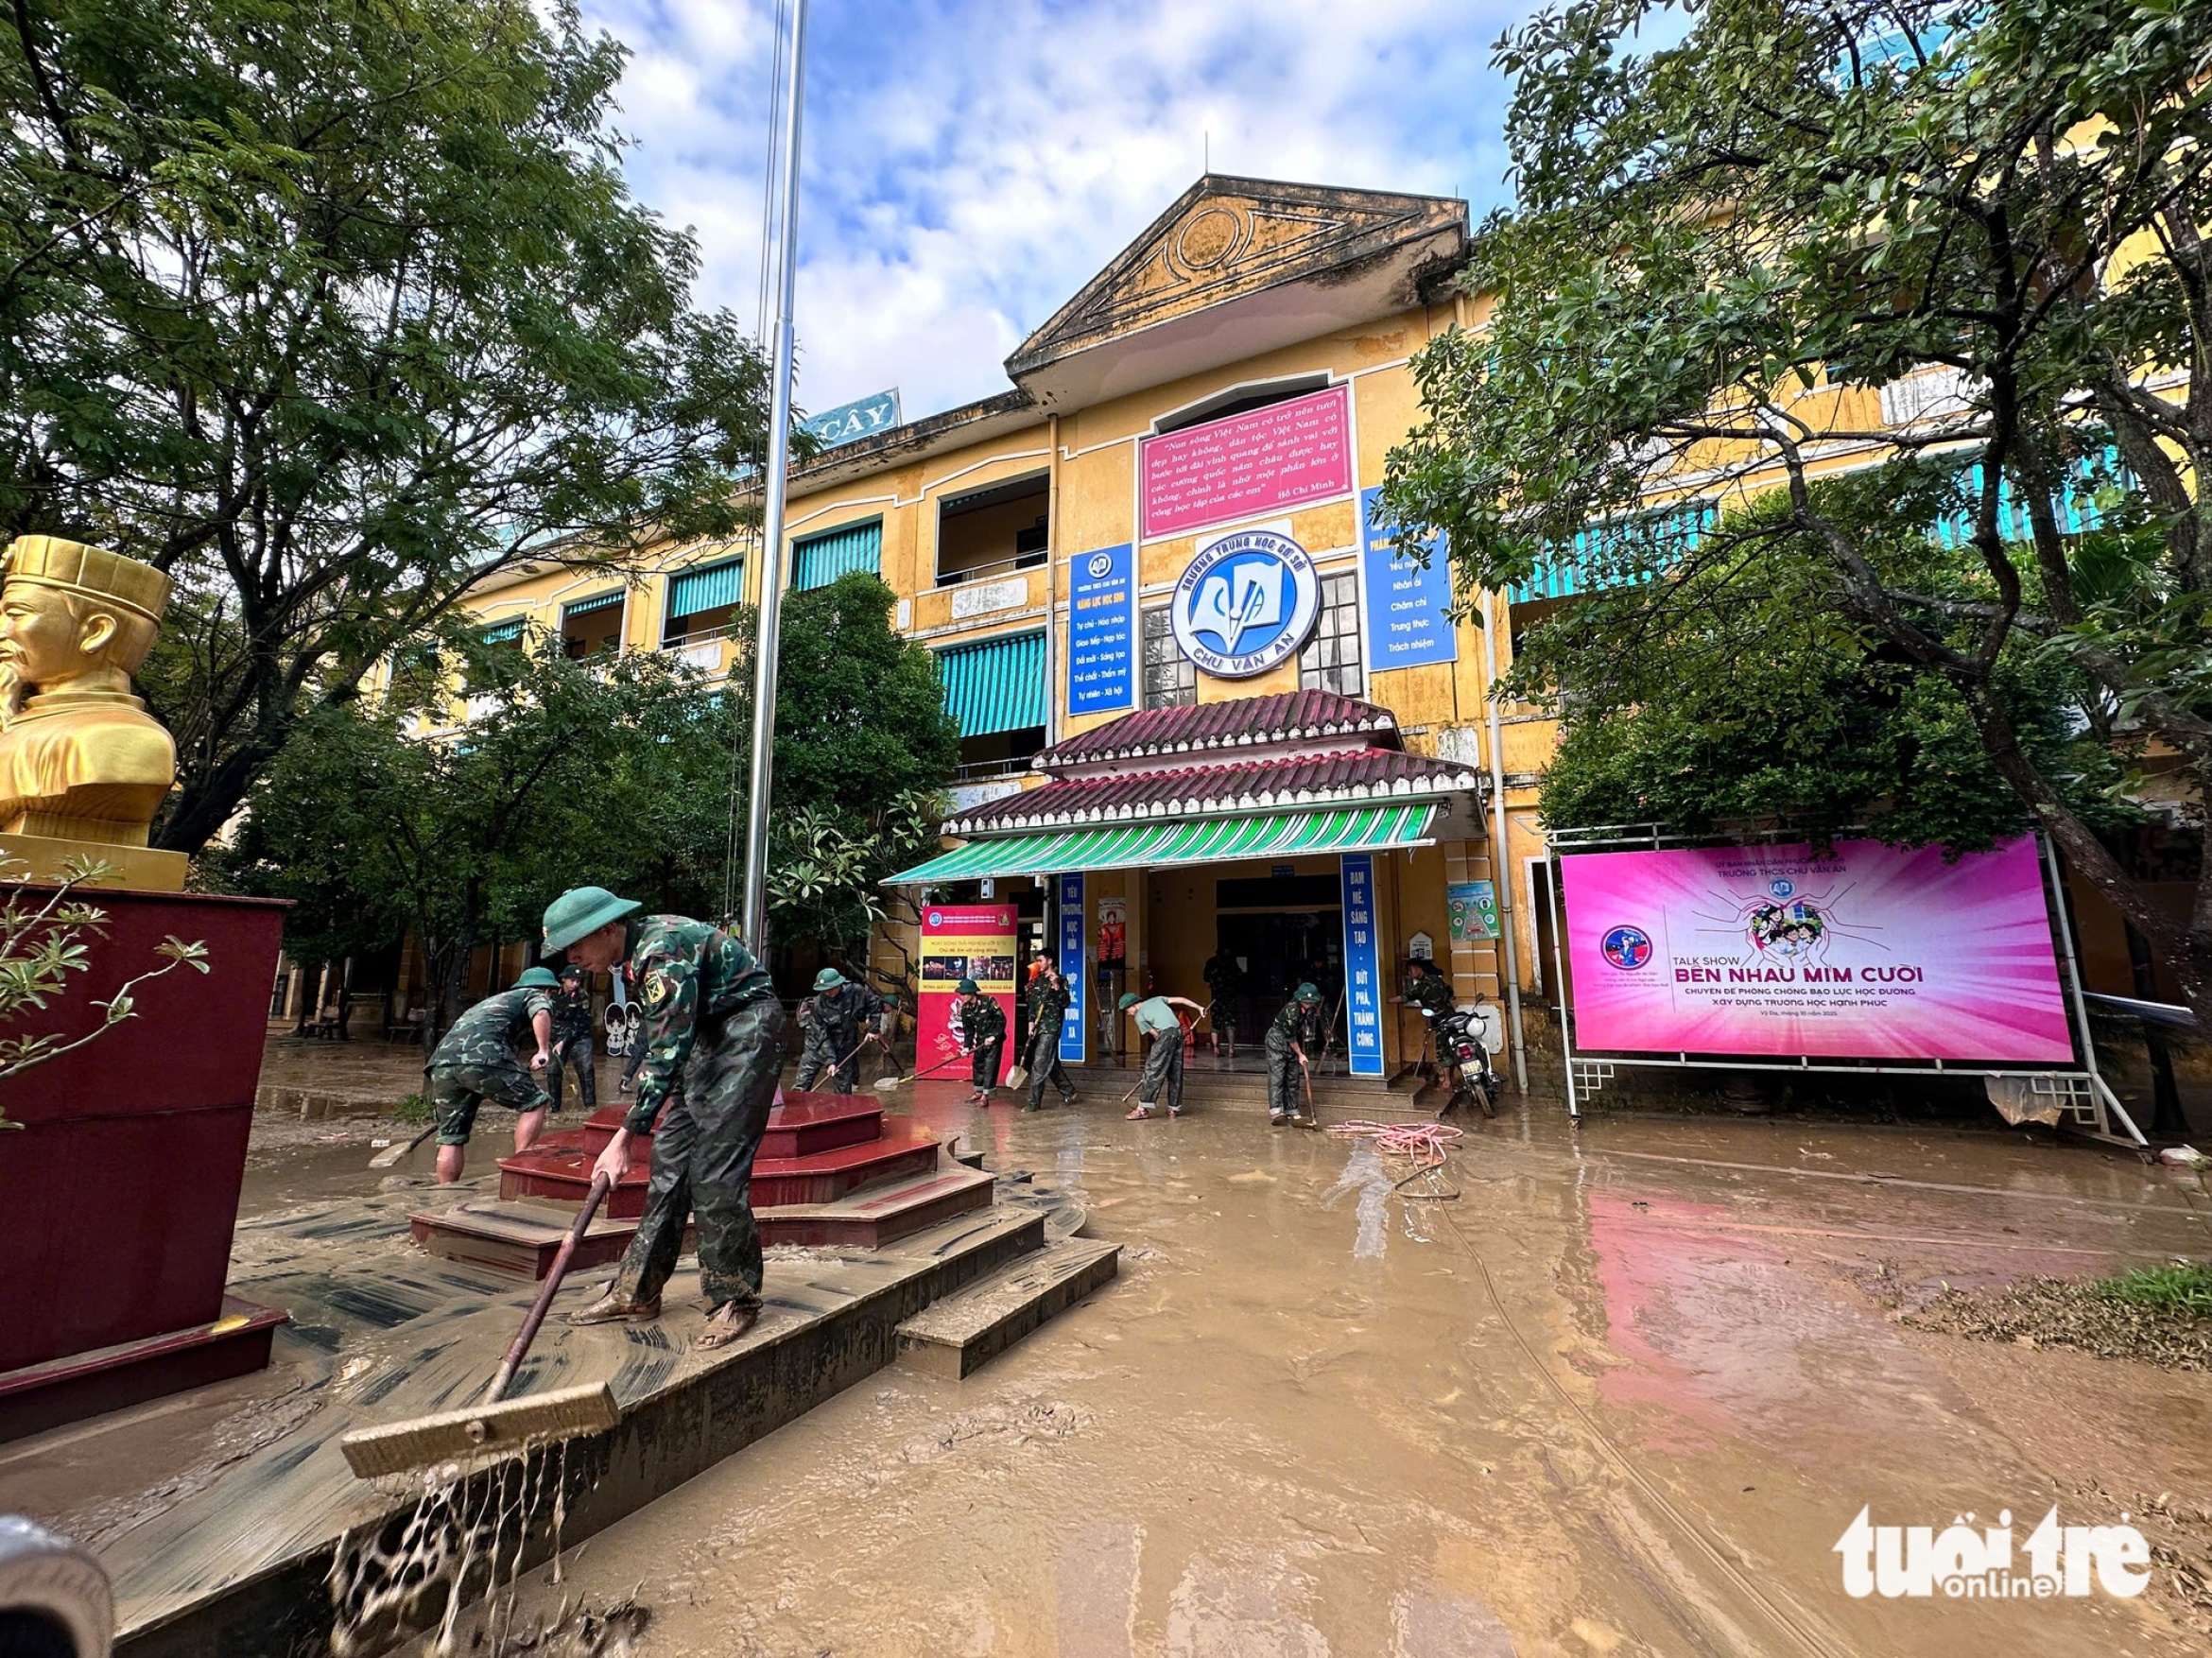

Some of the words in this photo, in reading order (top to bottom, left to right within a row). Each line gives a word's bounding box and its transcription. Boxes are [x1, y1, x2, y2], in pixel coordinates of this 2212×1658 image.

[1189, 434, 1212, 445] sông
[1214, 427, 1233, 439] Việt
[1236, 422, 1258, 432] Nam
[1261, 417, 1273, 426] có
[1276, 410, 1292, 422] trở
[1295, 406, 1314, 417] nên
[1317, 399, 1337, 411] tươi
[1151, 458, 1167, 469] đẹp
[1171, 453, 1188, 463] hay
[1229, 438, 1247, 448] dân
[1252, 431, 1267, 442] tộc
[1272, 424, 1290, 436] Việt
[1295, 419, 1319, 430] Nam
[1324, 412, 1338, 423] có
[1151, 468, 1172, 480] bước
[1176, 464, 1188, 474] tới
[1190, 459, 1204, 471] đài
[1206, 454, 1226, 466] vinh
[1230, 446, 1260, 461] quang
[1262, 440, 1275, 452] để
[1277, 436, 1300, 448] sánh
[1304, 431, 1318, 441] vai
[1322, 426, 1338, 437] với
[1151, 483, 1166, 493] các
[1171, 475, 1199, 488] cường
[1203, 467, 1226, 480] quốc
[1232, 462, 1253, 473] năm
[1259, 455, 1283, 466] châu
[1288, 447, 1314, 458] được
[1320, 440, 1339, 451] hay
[1186, 484, 1212, 496] chính
[1218, 480, 1226, 490] là
[1232, 475, 1252, 486] nhờ
[1256, 469, 1275, 480] một
[1280, 461, 1305, 476] phần
[1310, 457, 1327, 468] lớn
[1331, 452, 1339, 462] ở
[1278, 488, 1290, 499] Hồ
[1292, 484, 1308, 495] Chí
[1310, 479, 1335, 492] Minh
[1151, 507, 1172, 518] công
[1174, 502, 1191, 513] học
[1193, 499, 1208, 509] tập
[1209, 493, 1225, 505] của
[1227, 490, 1244, 500] các
[1183, 551, 1214, 591] TRƯỜNG
[1216, 537, 1250, 556] TRUNG
[1254, 536, 1276, 549] HỌC
[1277, 544, 1295, 560] CƠ
[1289, 555, 1308, 572] SỞ
[1390, 561, 1403, 572] Yêu
[1392, 579, 1413, 592] Nhân
[1414, 578, 1422, 587] ái
[1391, 600, 1413, 612] Chăm
[1415, 596, 1427, 607] chỉ
[1084, 618, 1095, 630] chủ
[1111, 614, 1126, 625] nhập
[1391, 620, 1411, 632] Trung
[1412, 618, 1430, 629] thực
[1076, 638, 1089, 648] Giao
[1090, 635, 1101, 646] tiếp
[1103, 633, 1115, 645] Hợp
[1115, 631, 1126, 641] tác
[1389, 642, 1409, 652] Trách
[1410, 638, 1435, 650] nhiệm
[1076, 654, 1086, 665] Đổi
[1085, 654, 1097, 664] mới
[1100, 651, 1115, 662] Sáng
[1115, 650, 1126, 660] tạo
[1193, 648, 1224, 670] CHU
[1232, 654, 1265, 671] VĂN
[1274, 632, 1296, 655] AN
[1074, 671, 1084, 682] Thể
[1085, 670, 1097, 682] chất
[1101, 667, 1115, 679] Thẩm
[1086, 689, 1101, 699] nhiên
[1104, 687, 1114, 697] Xã
[1114, 685, 1123, 696] hội
[1350, 871, 1365, 885] ĐAM
[1759, 867, 1785, 876] THCS
[1787, 867, 1808, 875] CHU
[1809, 864, 1830, 874] VĂN
[1833, 864, 1847, 873] AN
[1351, 908, 1368, 924] SÁNG
[1354, 930, 1367, 947] TẠO
[1673, 957, 1700, 965] TALK
[1702, 957, 1740, 965] SHOW
[1356, 968, 1368, 985] BỨT
[1675, 965, 1721, 982] BÊN
[1728, 968, 1796, 982] NHAU
[1860, 963, 1924, 982] CƯỜI
[1810, 988, 1830, 997] BẠO
[1855, 988, 1876, 997] HỌC
[1807, 999, 1827, 1008] HỌC
[1353, 1009, 1374, 1027] THÀNH
[1067, 1027, 1076, 1039] XA
[1357, 1029, 1374, 1047] CÔNG
